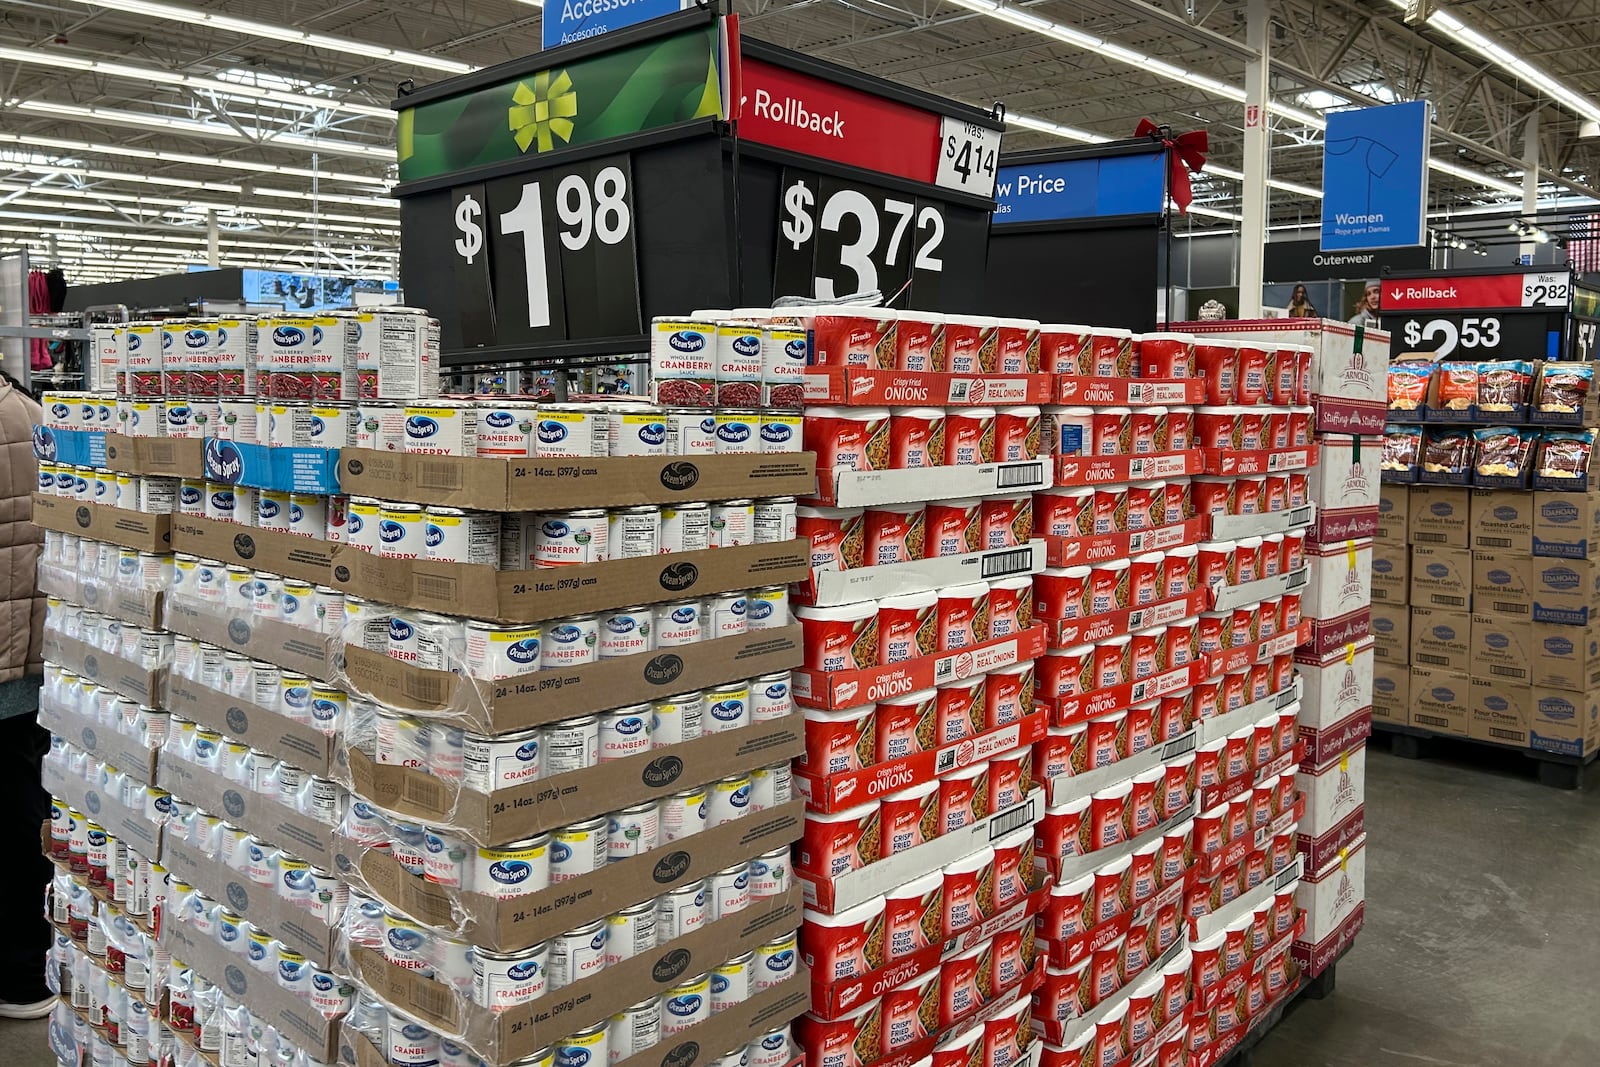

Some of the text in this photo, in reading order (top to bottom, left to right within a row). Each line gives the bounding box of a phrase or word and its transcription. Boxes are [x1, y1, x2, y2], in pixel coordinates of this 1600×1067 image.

[561, 24, 608, 45] Accesorios
[754, 89, 846, 139] Rollback
[1018, 174, 1065, 196] Price
[1336, 214, 1384, 225] Women
[1313, 254, 1375, 266] Outerwear
[1537, 275, 1557, 283] Was:
[1406, 287, 1457, 299] Rollback
[848, 354, 870, 362] CRISPY
[907, 356, 926, 364] CRISPY
[660, 361, 713, 370] CRANBERRY
[893, 378, 922, 387] Crispy Fried
[1346, 371, 1369, 382] ARNOLD
[885, 388, 928, 400] ONIONS
[1003, 389, 1025, 398] ONIONS
[1084, 390, 1114, 402] ONIONS
[1323, 411, 1385, 430] Stuffing Stuffing
[478, 434, 524, 442] CRANBERRY
[207, 450, 240, 479] Ocean Spray
[515, 468, 526, 477] 24
[557, 467, 580, 477] (397g)
[1085, 469, 1115, 481] ONIONS
[1346, 480, 1366, 489] ARNOLD
[1543, 508, 1577, 517] IDAHOAN
[1325, 523, 1347, 536] Stuffing
[1481, 521, 1508, 529] Roasted
[536, 545, 580, 554] CRANBERRY
[878, 545, 899, 553] CRISPY
[1086, 546, 1116, 559] ONIONS
[1544, 574, 1578, 583] IDAHOAN
[513, 585, 526, 594] 24
[558, 578, 580, 590] (397g)
[582, 577, 597, 586] cans
[1083, 624, 1114, 642] ONIONS
[1323, 631, 1344, 647] Stuffing
[889, 642, 910, 650] CRISPY
[889, 649, 907, 657] FRIED
[977, 650, 1015, 669] REAL ONIONS
[516, 666, 535, 674] JELLIED
[876, 670, 905, 684] Crispy Fried
[496, 688, 507, 699] 24
[539, 677, 563, 693] (397g)
[564, 676, 580, 686] cans
[868, 677, 913, 700] ONIONS
[1085, 699, 1117, 715] ONIONS
[1539, 703, 1575, 714] IDAHOAN
[947, 719, 965, 727] CRISPY
[947, 725, 963, 734] FRIED
[946, 731, 967, 742] ONIONS
[605, 738, 649, 750] CRANBERRY
[978, 735, 1016, 756] REAL ONIONS
[877, 762, 907, 777] Crispy Fried
[868, 769, 913, 795] ONIONS
[494, 804, 505, 814] 24
[536, 787, 560, 805] (397g)
[561, 785, 578, 796] cans
[513, 913, 525, 923] 24
[554, 897, 576, 911] (397g)
[577, 889, 593, 901] cans
[984, 921, 1000, 935] REAL
[892, 931, 914, 940] CRISPY
[1089, 929, 1118, 952] ONIONS
[892, 938, 912, 947] FRIED
[891, 943, 917, 955] ONIONS
[872, 963, 919, 995] ONIONS
[495, 982, 545, 998] CRANBERRY
[891, 1020, 912, 1030] CRISPY
[890, 1032, 915, 1045] ONIONS
[891, 1028, 910, 1038] FRIED
